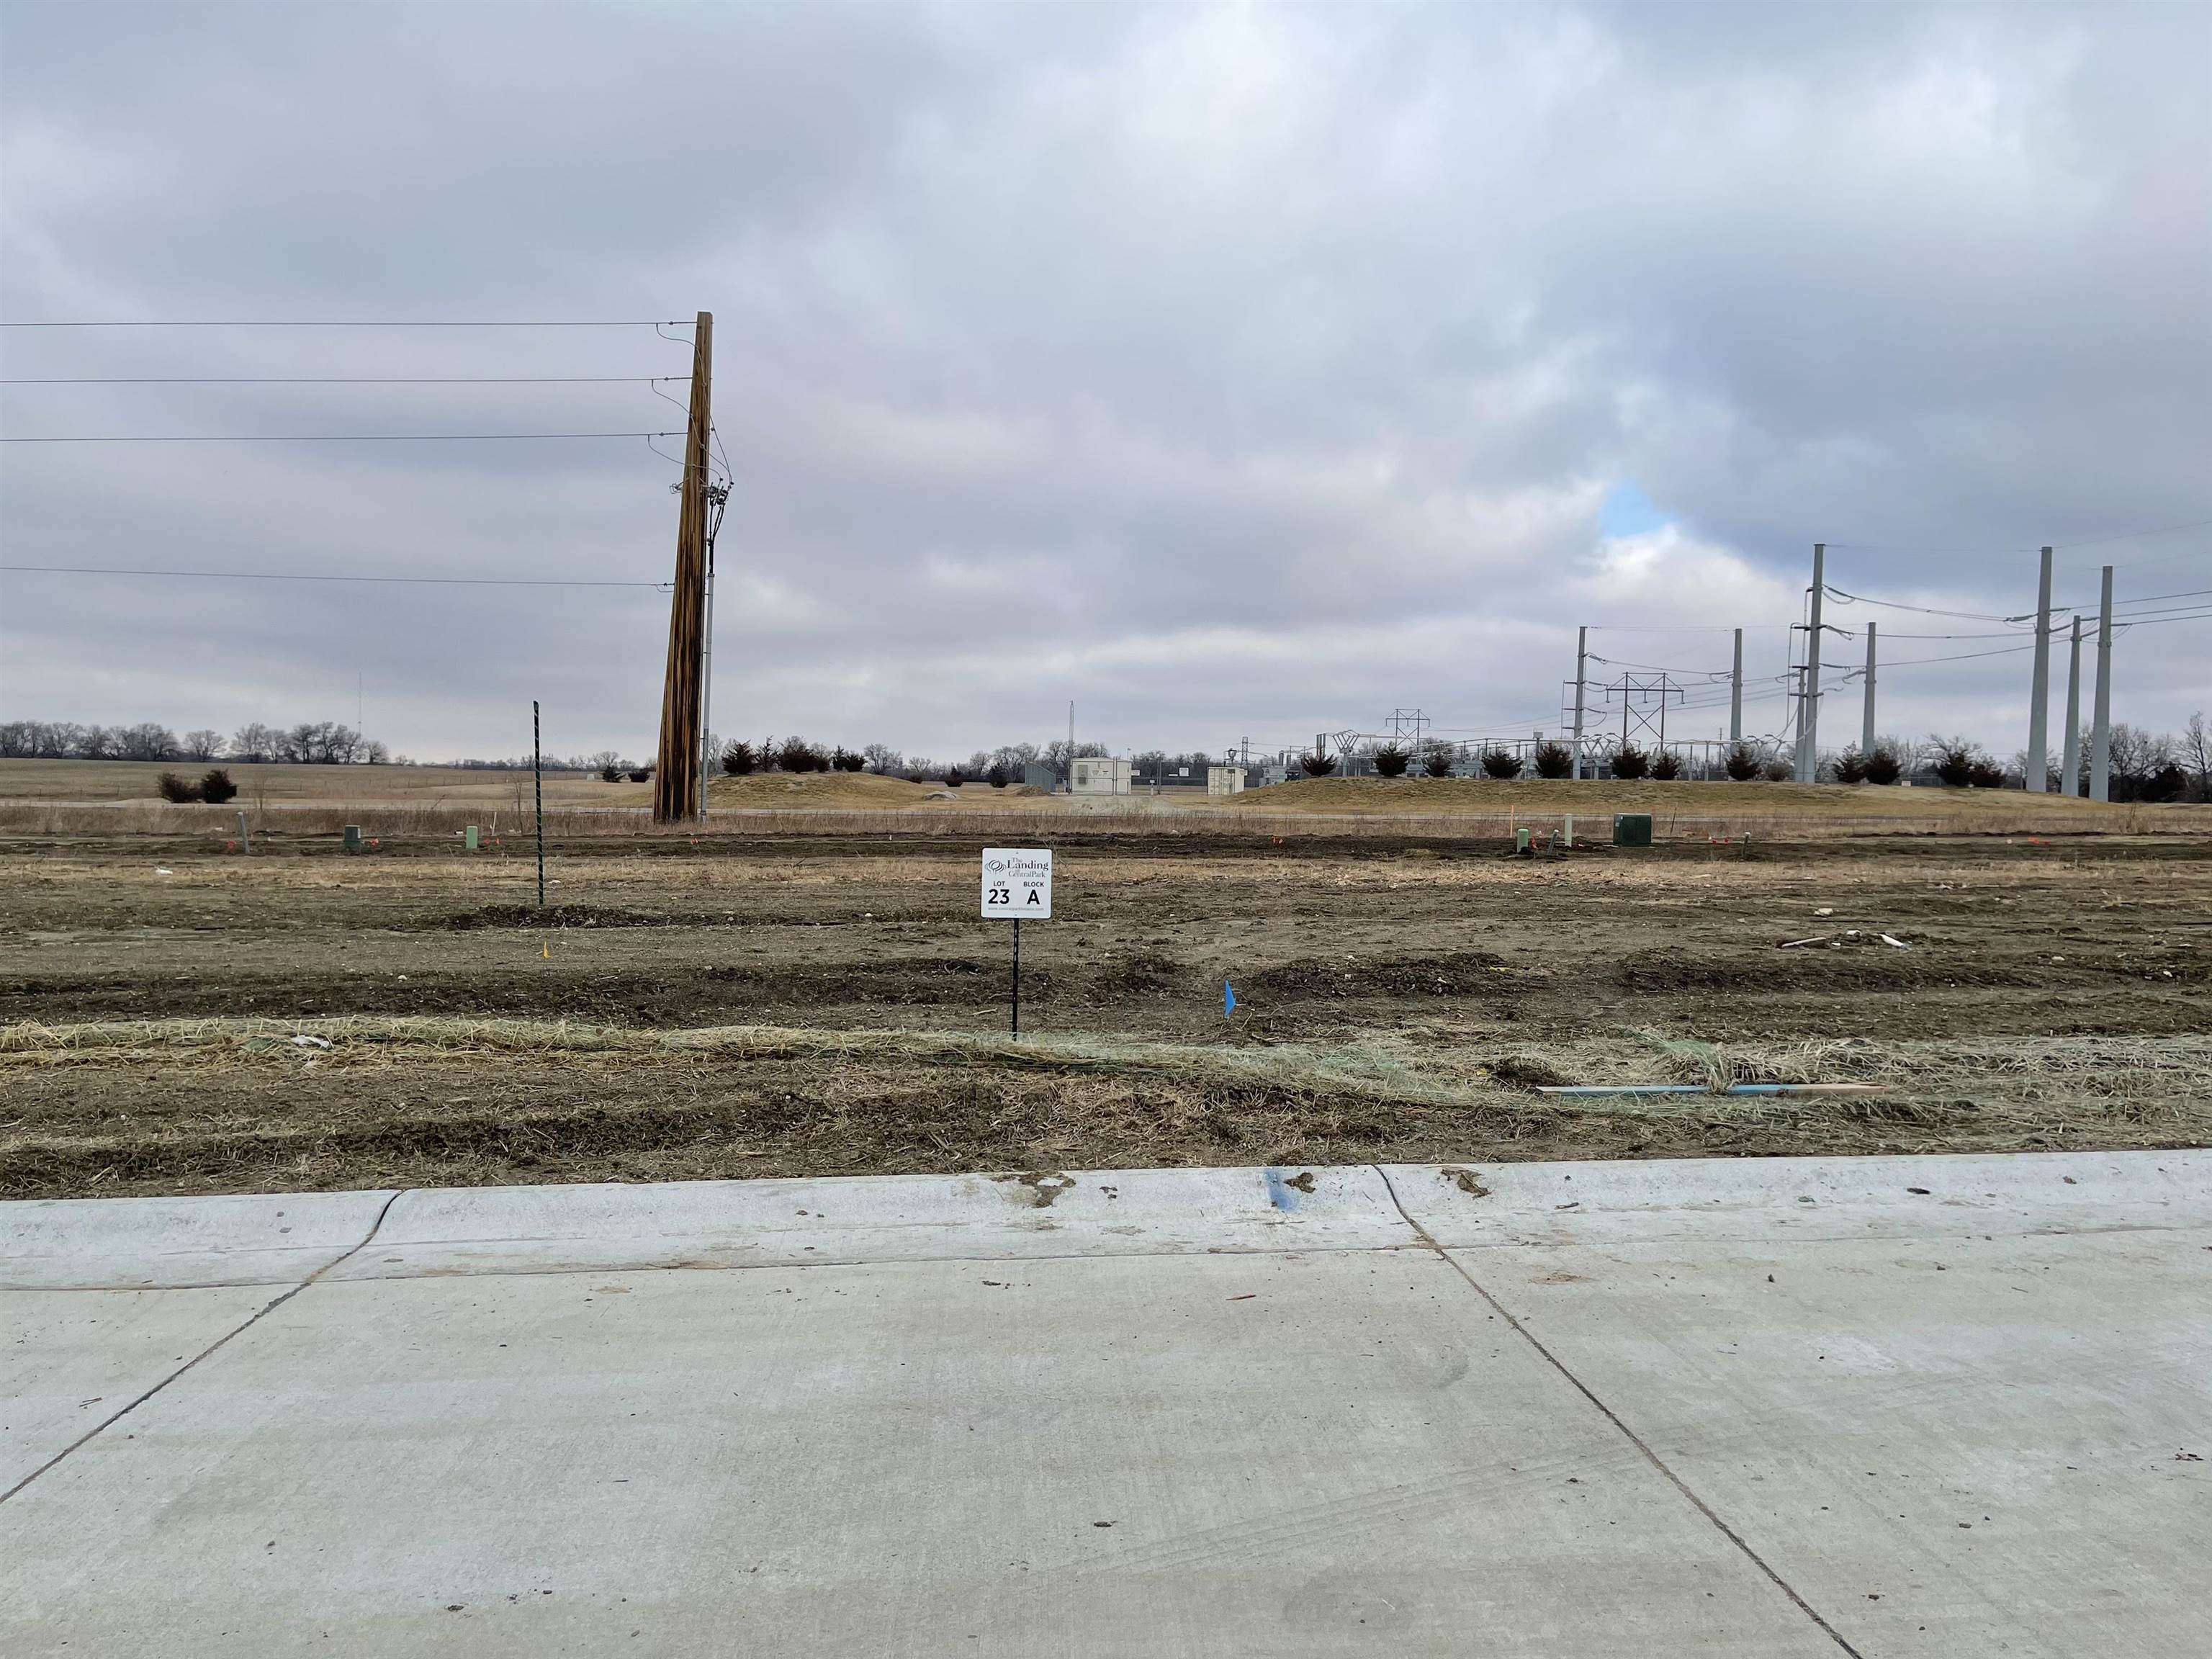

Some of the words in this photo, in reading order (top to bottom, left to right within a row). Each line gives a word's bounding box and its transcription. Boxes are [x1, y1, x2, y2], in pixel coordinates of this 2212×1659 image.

[1007, 860, 1048, 871] Landing
[988, 889, 1010, 904] 23
[1027, 889, 1040, 904] A
